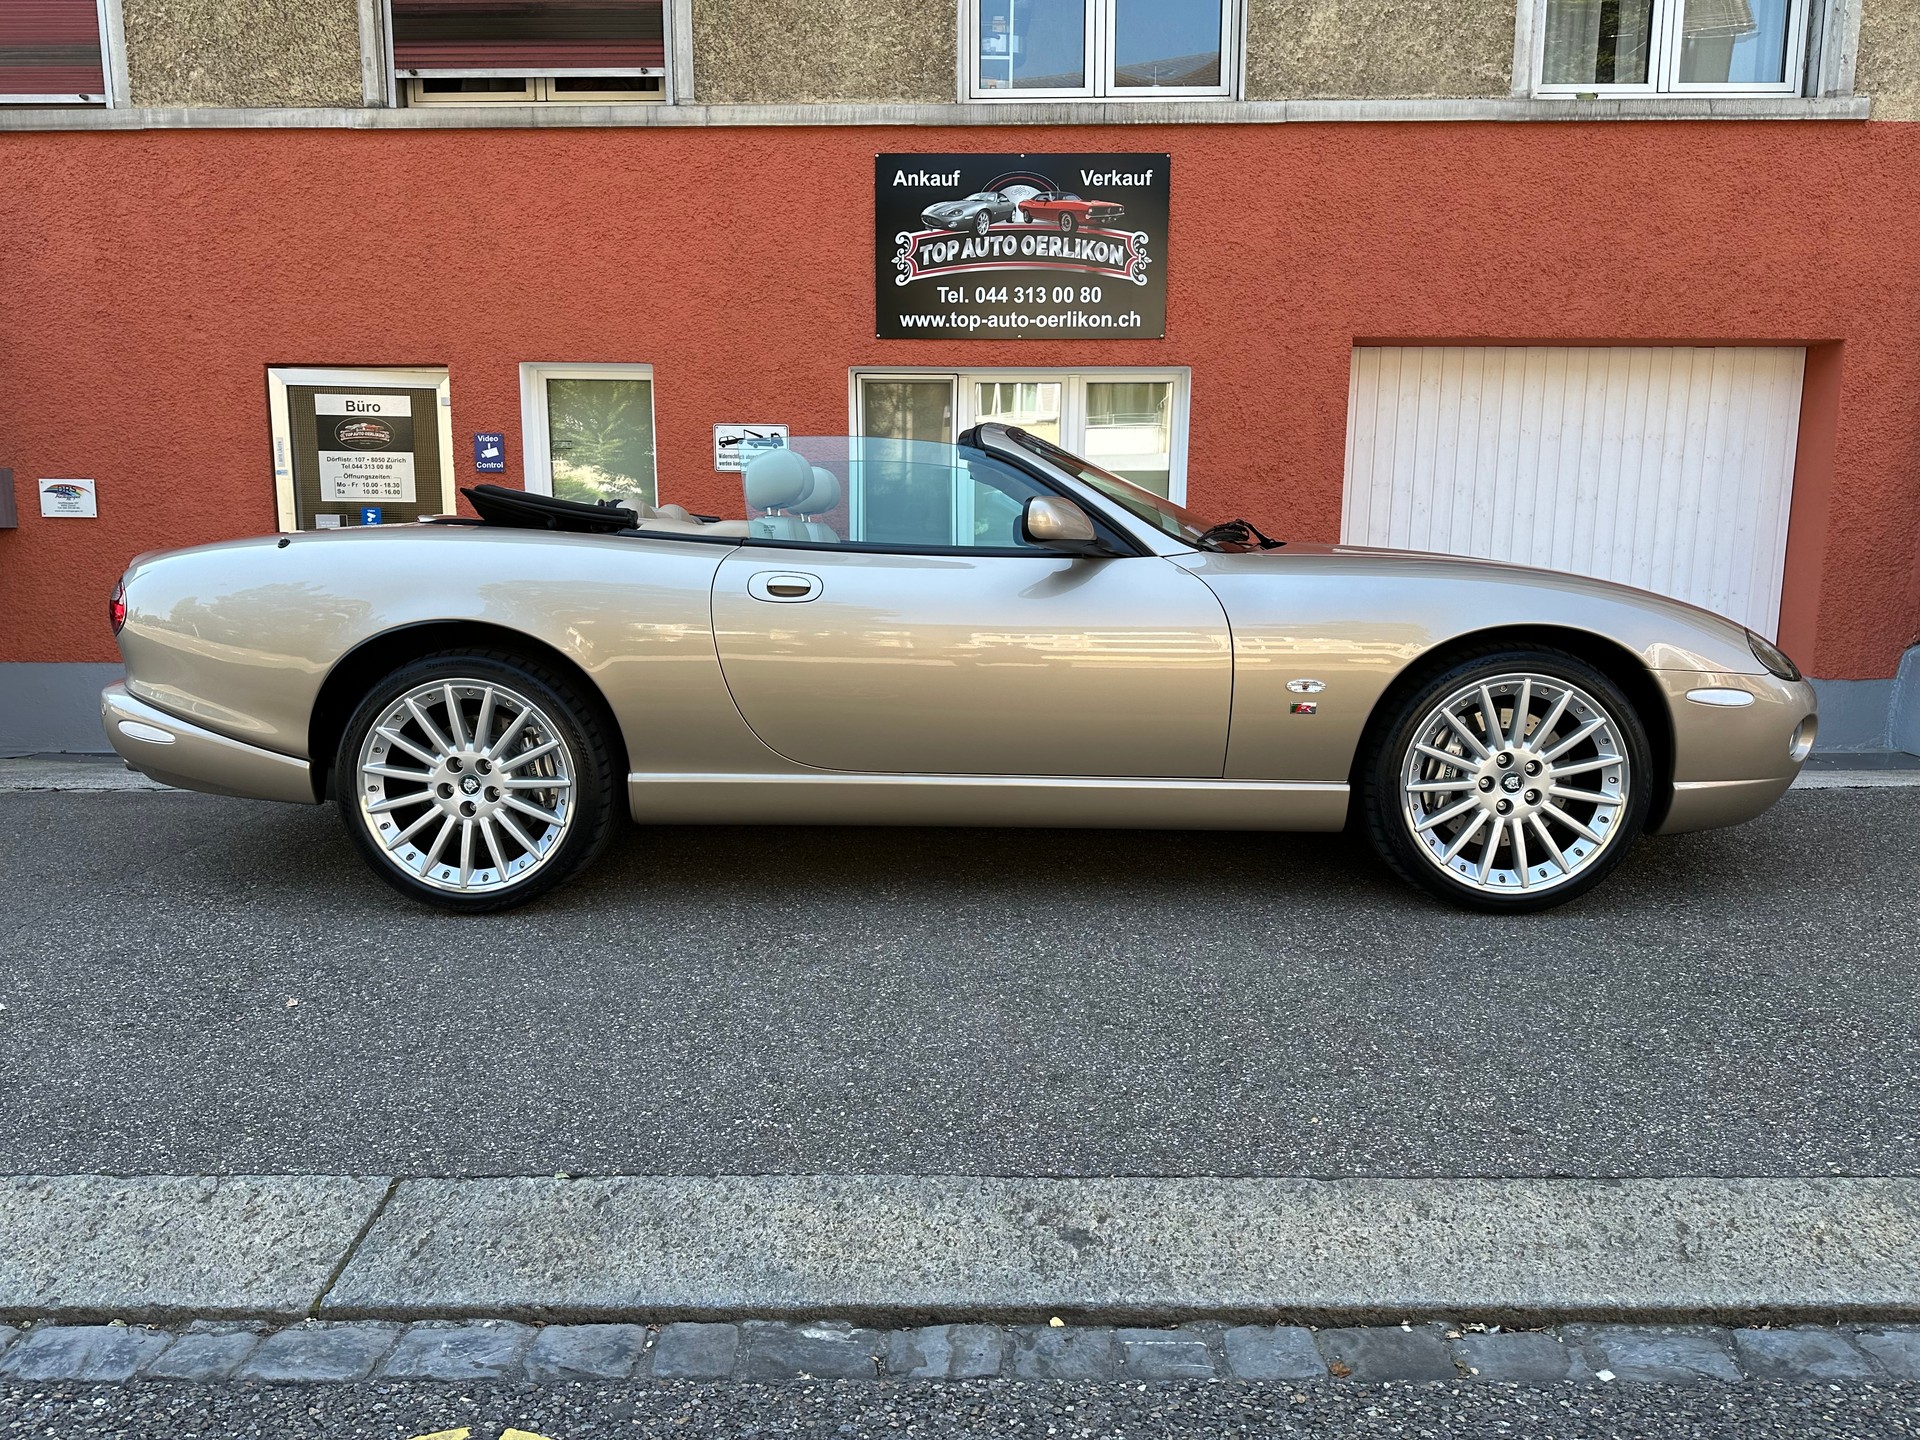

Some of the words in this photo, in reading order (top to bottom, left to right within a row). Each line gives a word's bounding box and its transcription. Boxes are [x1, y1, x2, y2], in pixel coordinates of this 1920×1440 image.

[893, 170, 960, 187] Ankauf
[1080, 169, 1153, 187] Verkauf
[919, 239, 960, 266] TOP
[961, 235, 1016, 259] AUTO
[1021, 235, 1125, 267] OERLIKON
[937, 286, 969, 304] Tel.
[975, 286, 1008, 304] 044
[1013, 286, 1047, 304] 313
[1052, 286, 1075, 304] 00
[1080, 286, 1102, 304] 80
[899, 311, 1141, 331] www.top-auto-oerlikon.ch
[345, 400, 381, 413] Büro
[476, 461, 504, 469] Control
